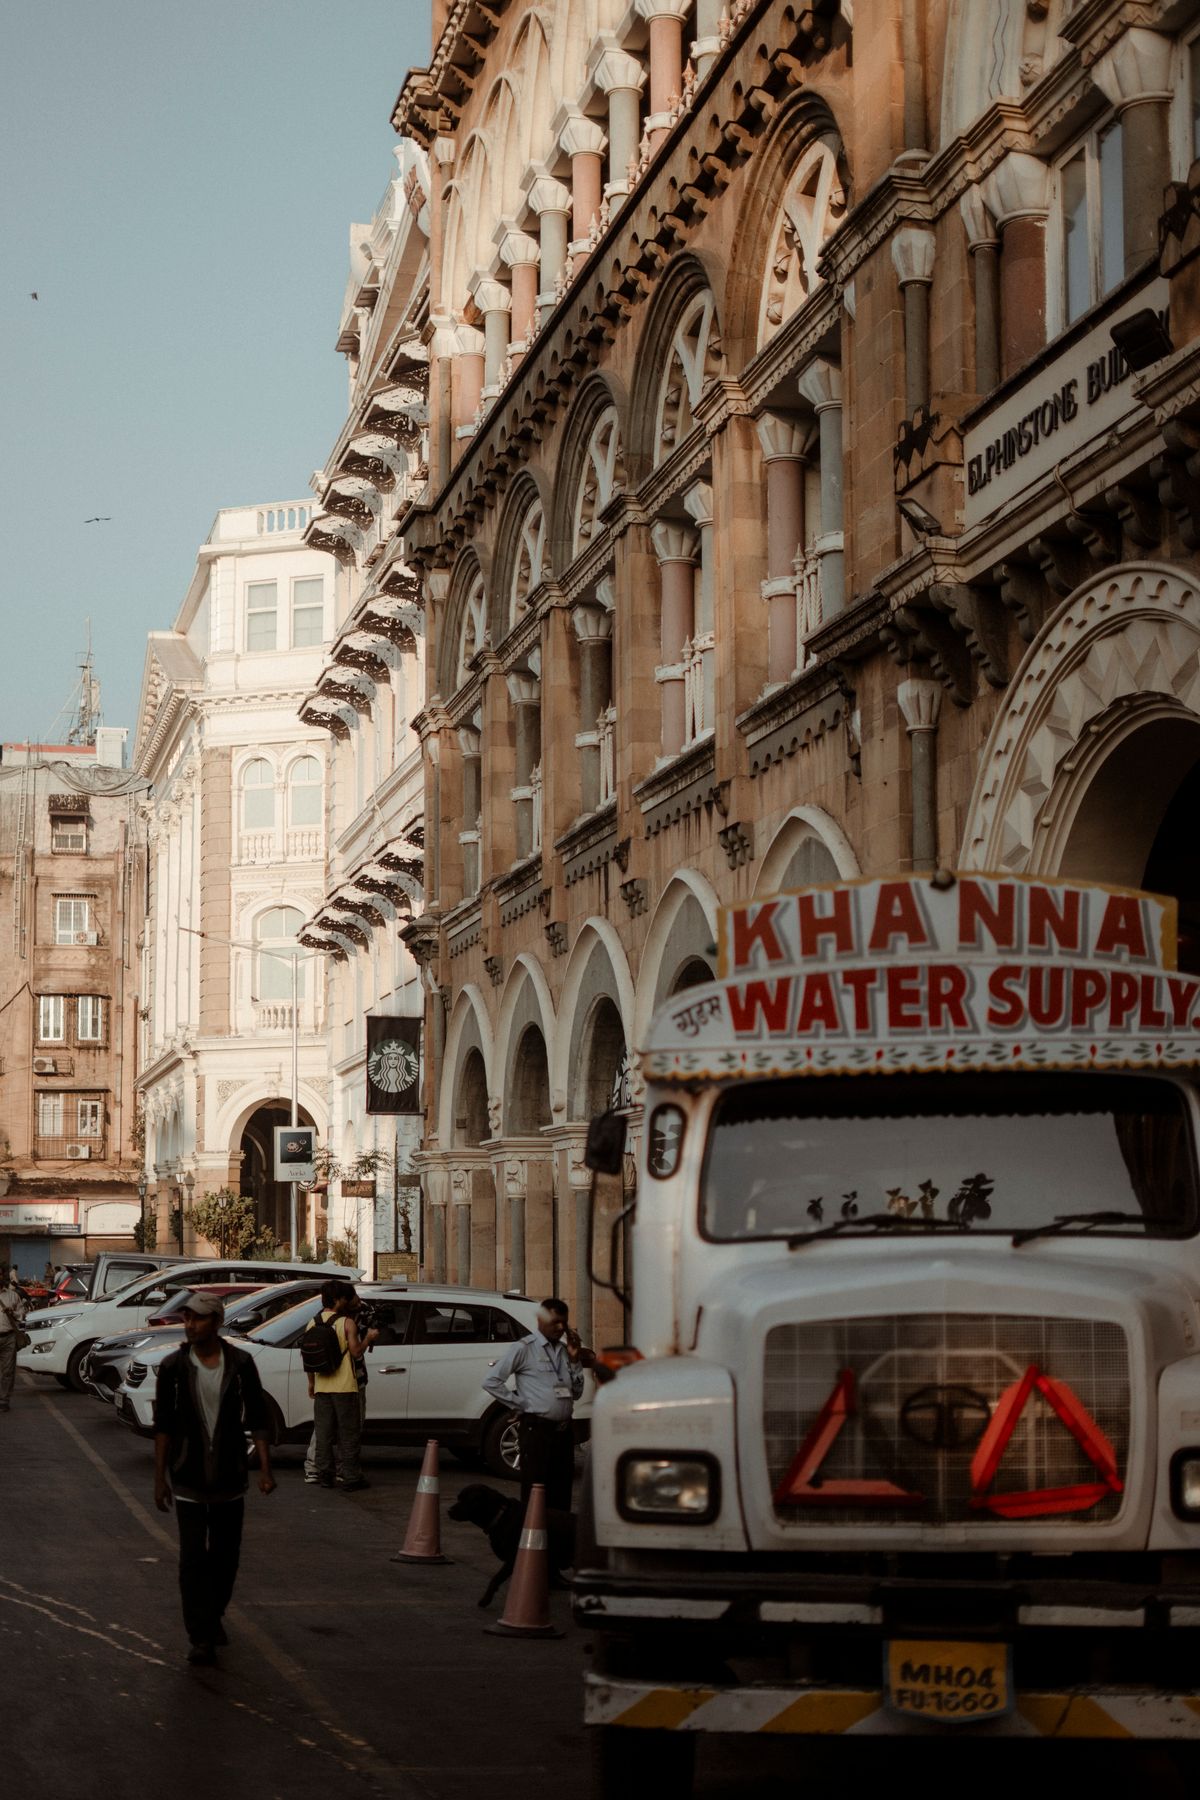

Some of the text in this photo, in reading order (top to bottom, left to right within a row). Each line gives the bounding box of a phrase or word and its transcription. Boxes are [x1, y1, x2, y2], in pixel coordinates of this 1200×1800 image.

[967, 378, 1078, 496] ELPHINSTONE
[732, 879, 1153, 968] KHANNA
[726, 964, 971, 1034] WATER
[901, 1661, 996, 1689] MH04
